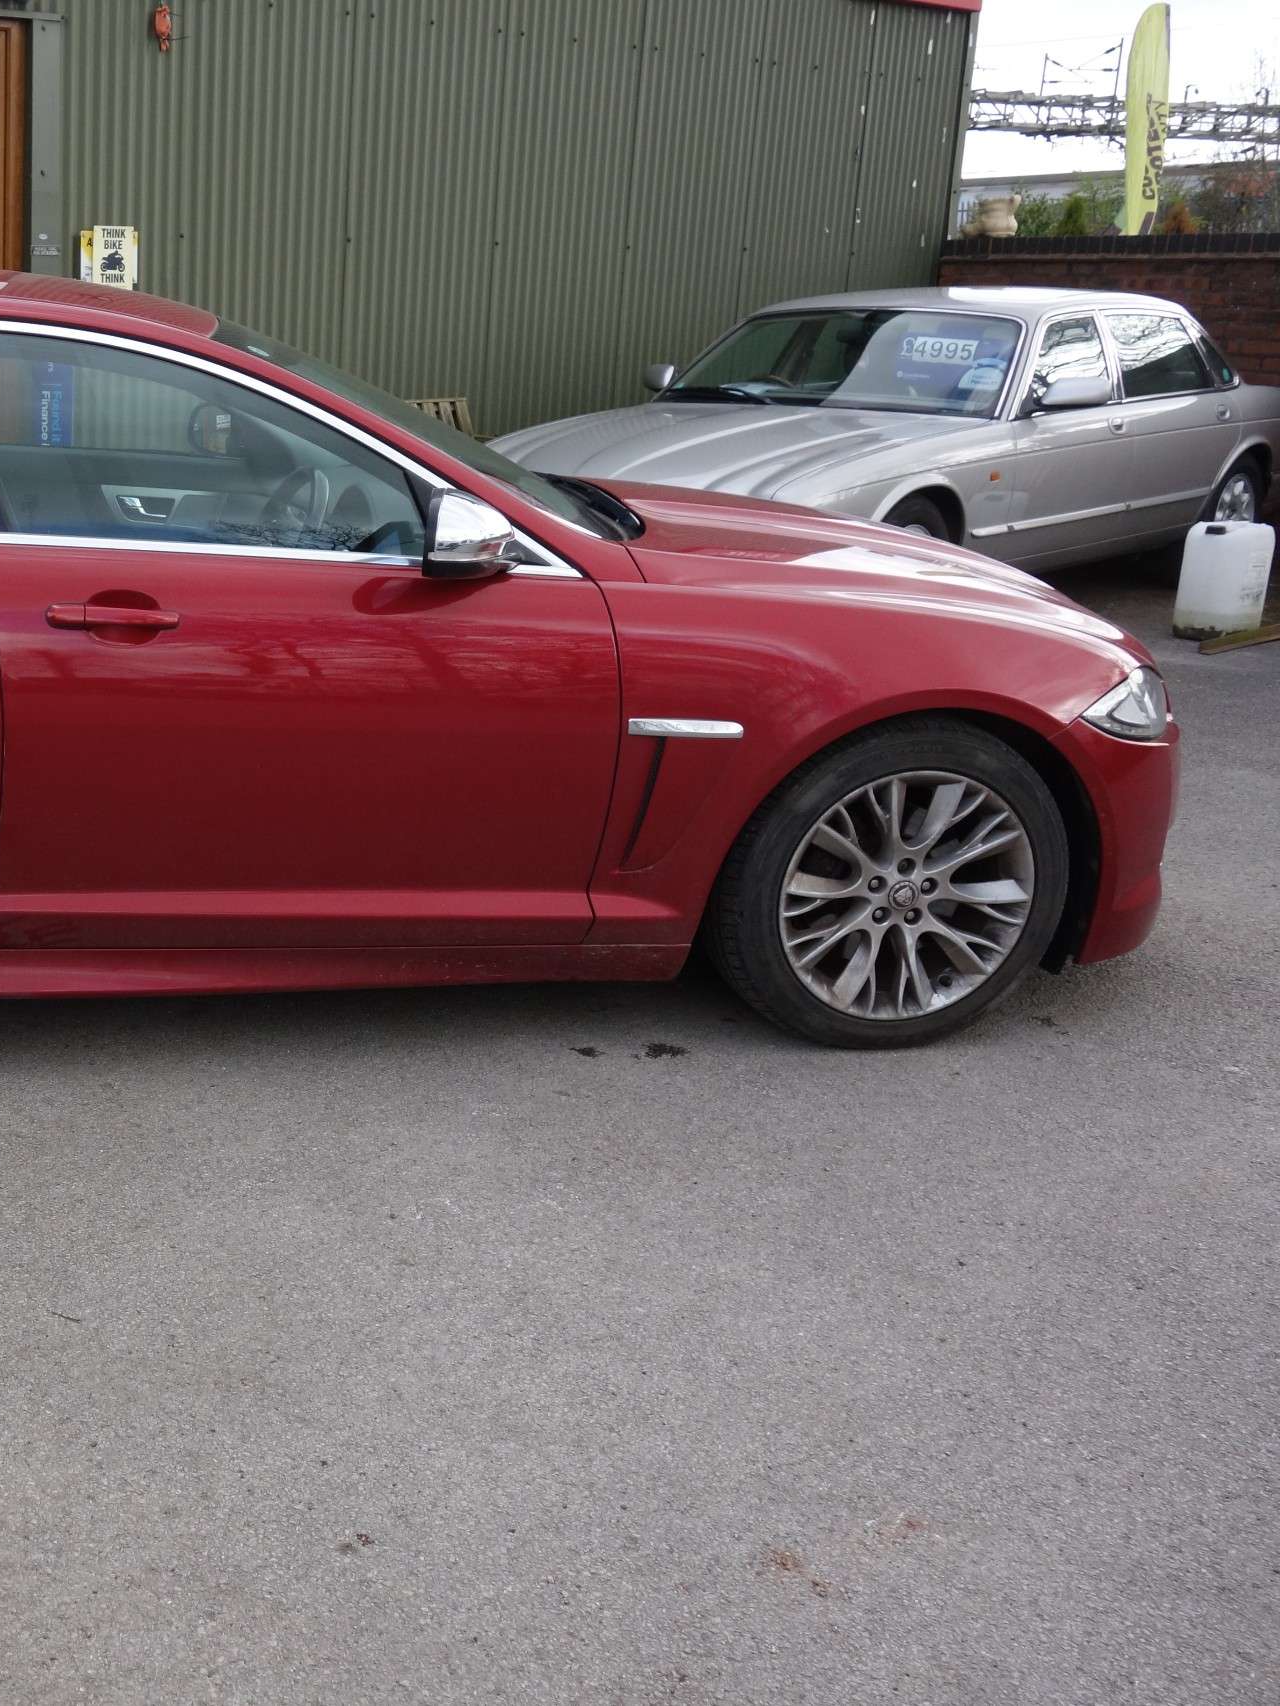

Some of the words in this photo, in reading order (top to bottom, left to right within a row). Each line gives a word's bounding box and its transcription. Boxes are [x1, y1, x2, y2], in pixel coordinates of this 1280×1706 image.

[102, 228, 126, 239] THINK
[104, 239, 123, 250] BIKE
[101, 273, 125, 284] THINK
[41, 390, 51, 441] Finance
